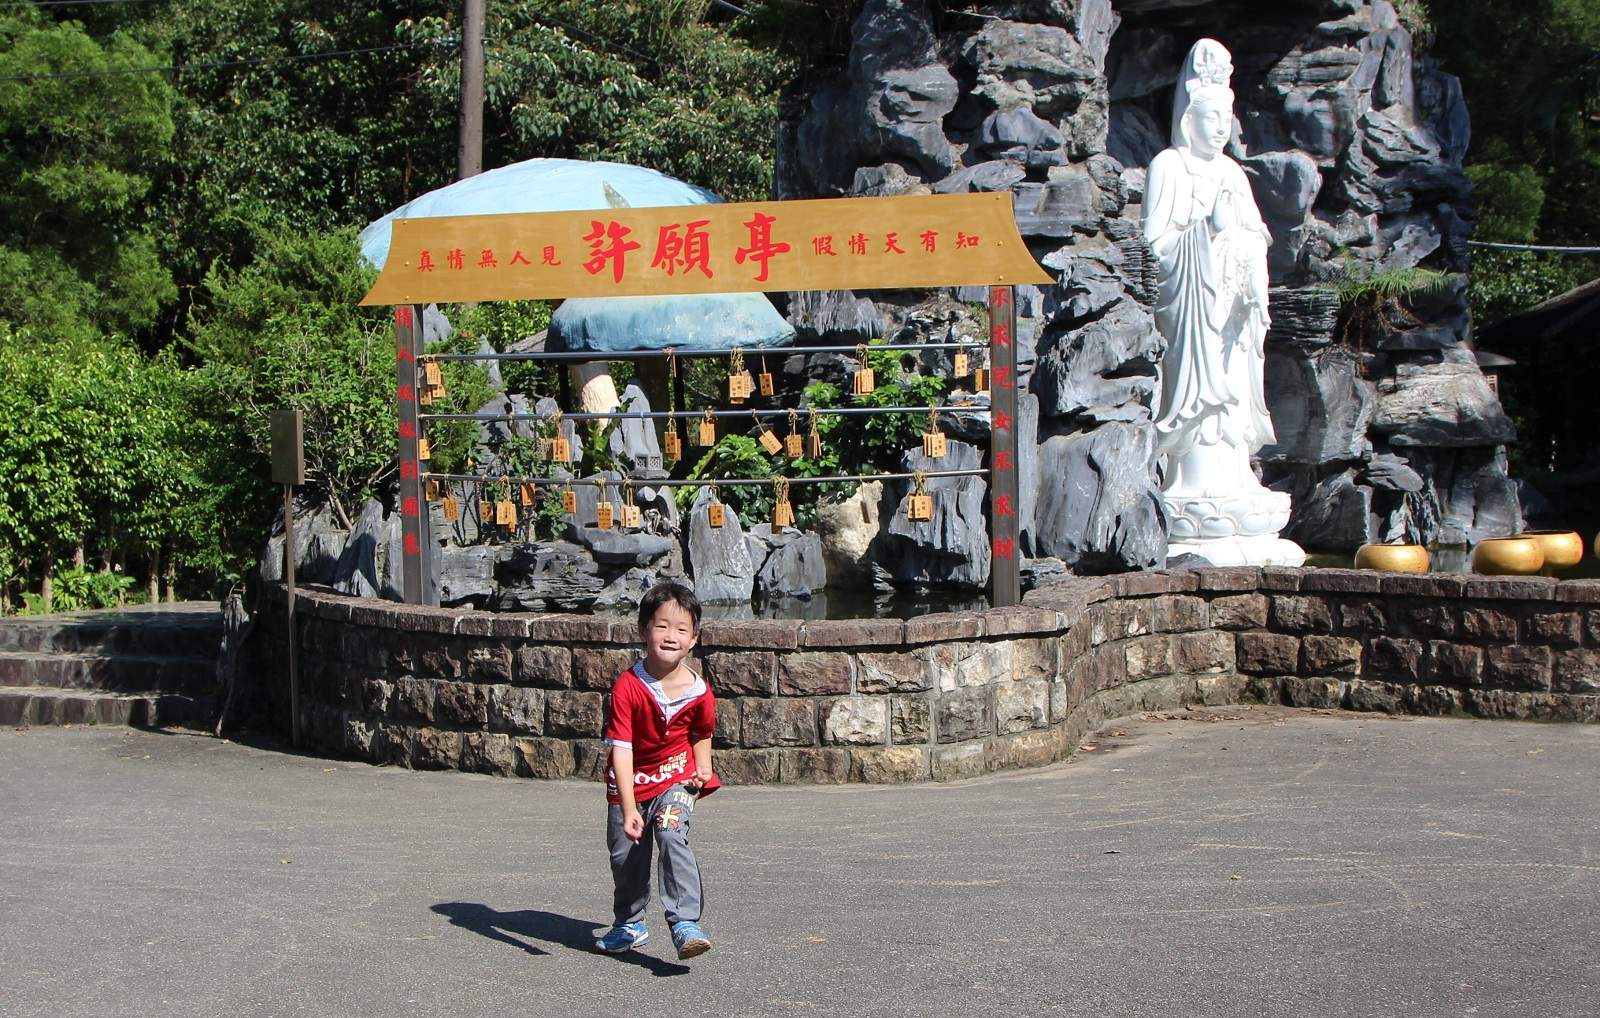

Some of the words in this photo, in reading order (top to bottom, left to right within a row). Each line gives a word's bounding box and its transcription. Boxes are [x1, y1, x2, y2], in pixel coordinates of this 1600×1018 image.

[583, 213, 790, 283] 許願亭
[812, 230, 980, 257] 假情天有知
[418, 246, 561, 273] 真情無人見
